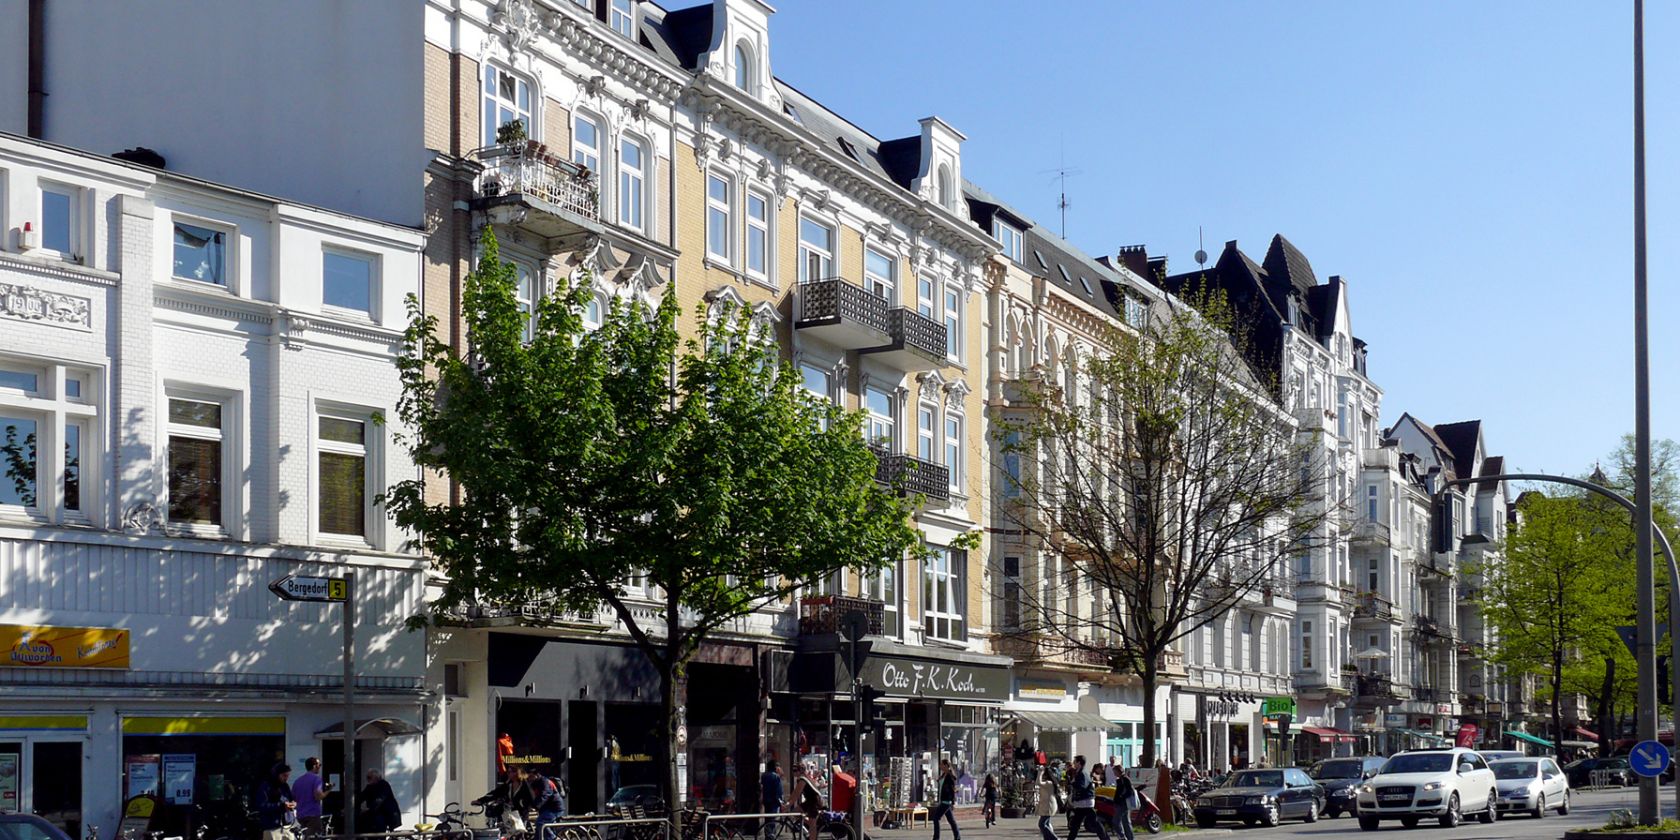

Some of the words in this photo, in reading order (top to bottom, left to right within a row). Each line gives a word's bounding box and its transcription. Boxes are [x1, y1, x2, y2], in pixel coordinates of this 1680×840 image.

[288, 580, 328, 595] Bergedorf
[334, 582, 341, 596] 5
[883, 662, 909, 688] Otto
[946, 667, 974, 692] Koch
[1269, 700, 1288, 711] Bio
